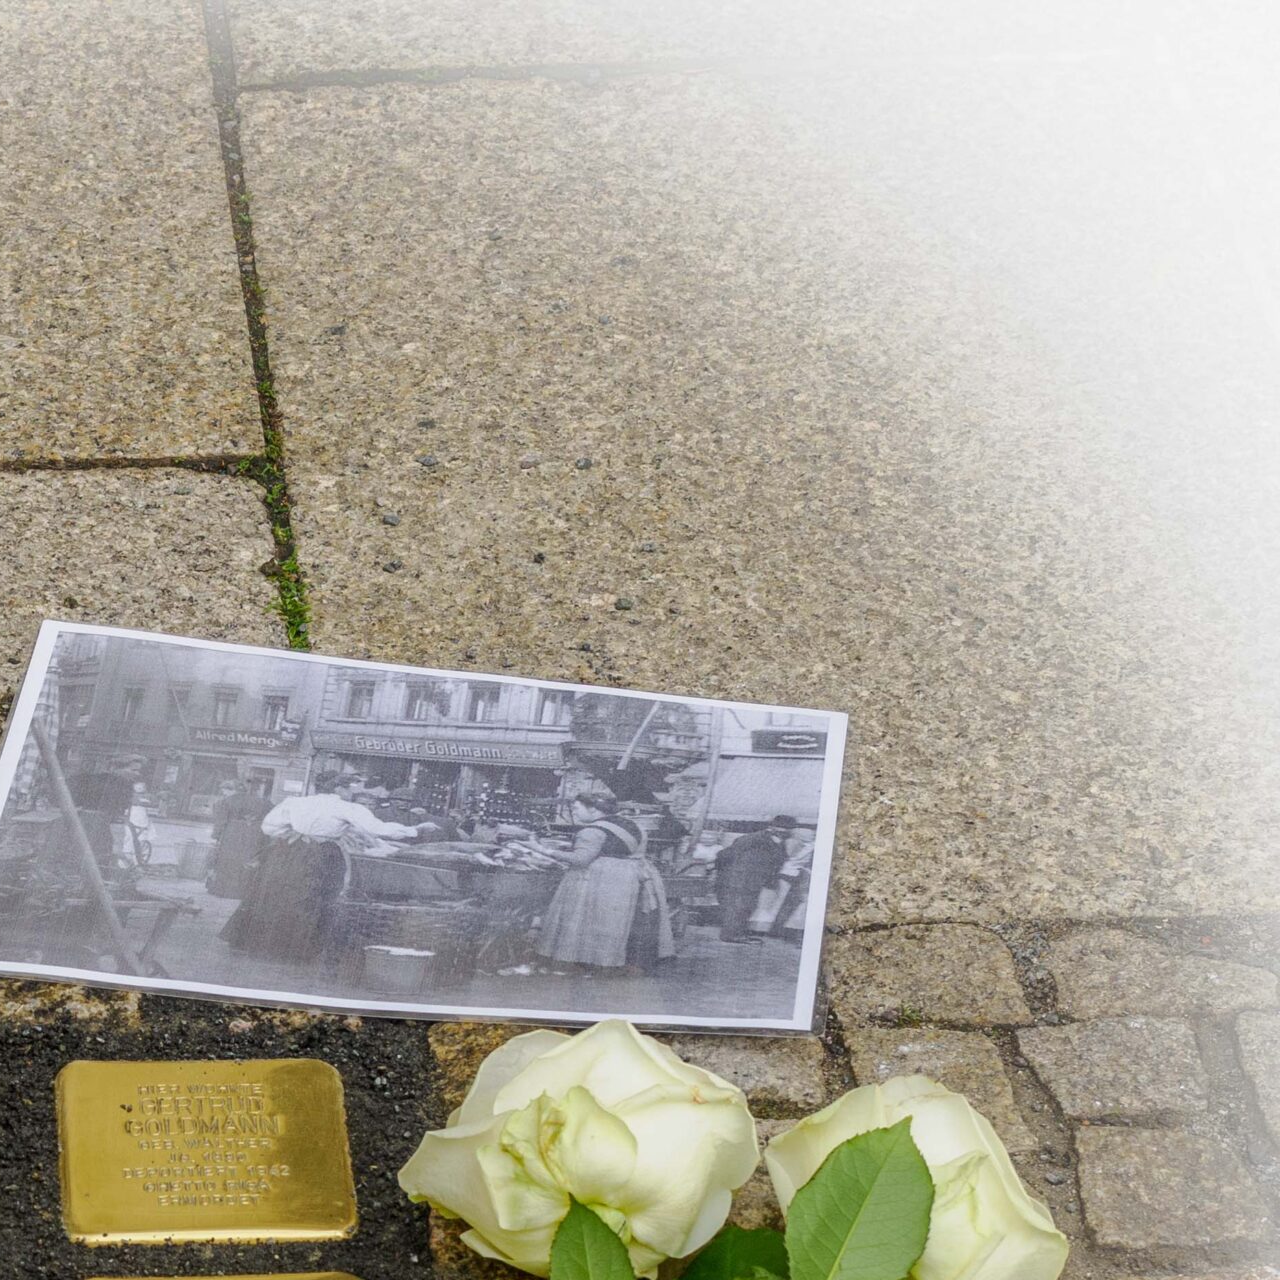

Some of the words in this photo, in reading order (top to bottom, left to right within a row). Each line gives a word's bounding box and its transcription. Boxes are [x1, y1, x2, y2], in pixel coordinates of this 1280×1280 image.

[195, 730, 234, 742] Alfred
[355, 736, 420, 753] Gebrüder
[425, 741, 501, 759] Goldmann
[137, 1084, 180, 1096] HIER
[187, 1083, 263, 1095] WOHNTE
[139, 1096, 265, 1115] GERTRUD
[125, 1115, 280, 1137] GOLDMANN
[139, 1139, 179, 1151] GEB.
[122, 1167, 238, 1179] DEPORTIERT
[143, 1181, 217, 1193] GHETTO
[222, 1180, 272, 1192] RIGA
[158, 1195, 262, 1207] ERMORDET
